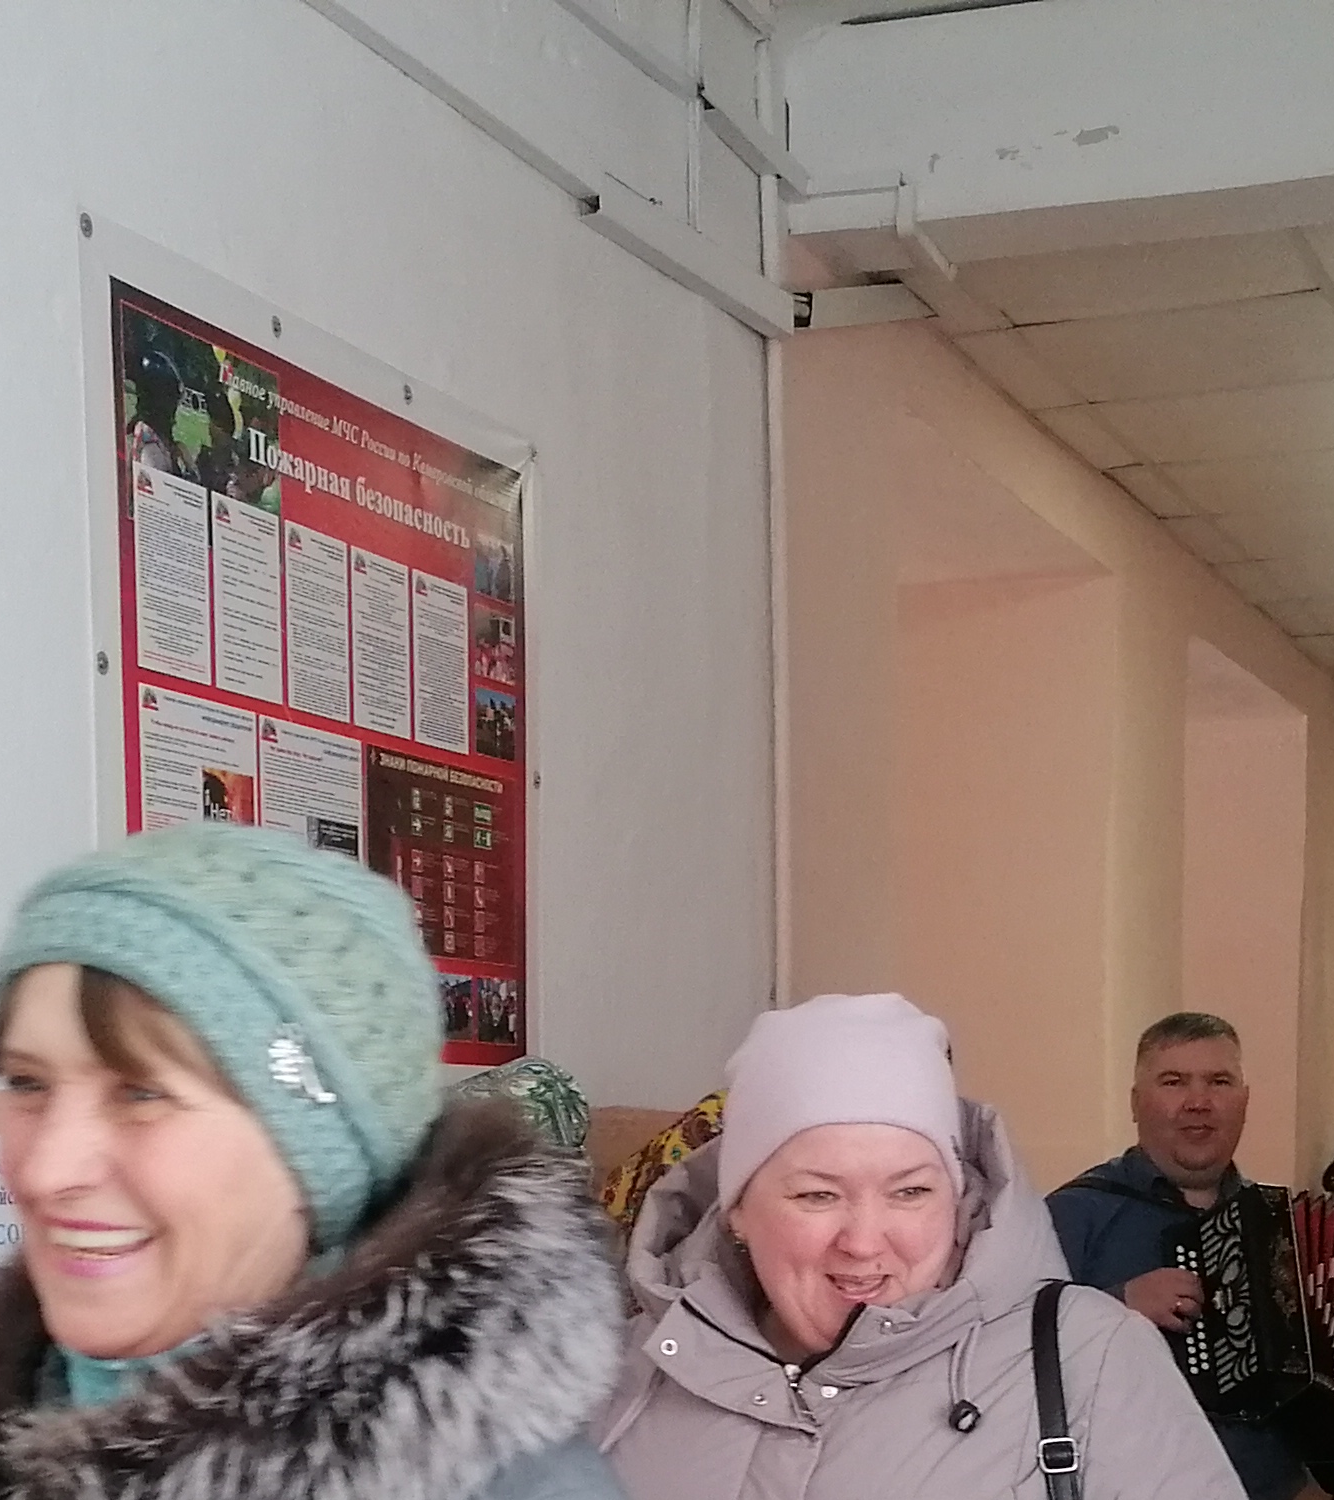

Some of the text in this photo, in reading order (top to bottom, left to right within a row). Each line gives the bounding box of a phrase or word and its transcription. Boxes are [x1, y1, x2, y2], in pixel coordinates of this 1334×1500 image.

[219, 362, 267, 401] Главное
[266, 391, 330, 431] управление
[331, 415, 360, 445] МЧС
[248, 427, 351, 500] Пожарная
[355, 475, 471, 549] безопасность
